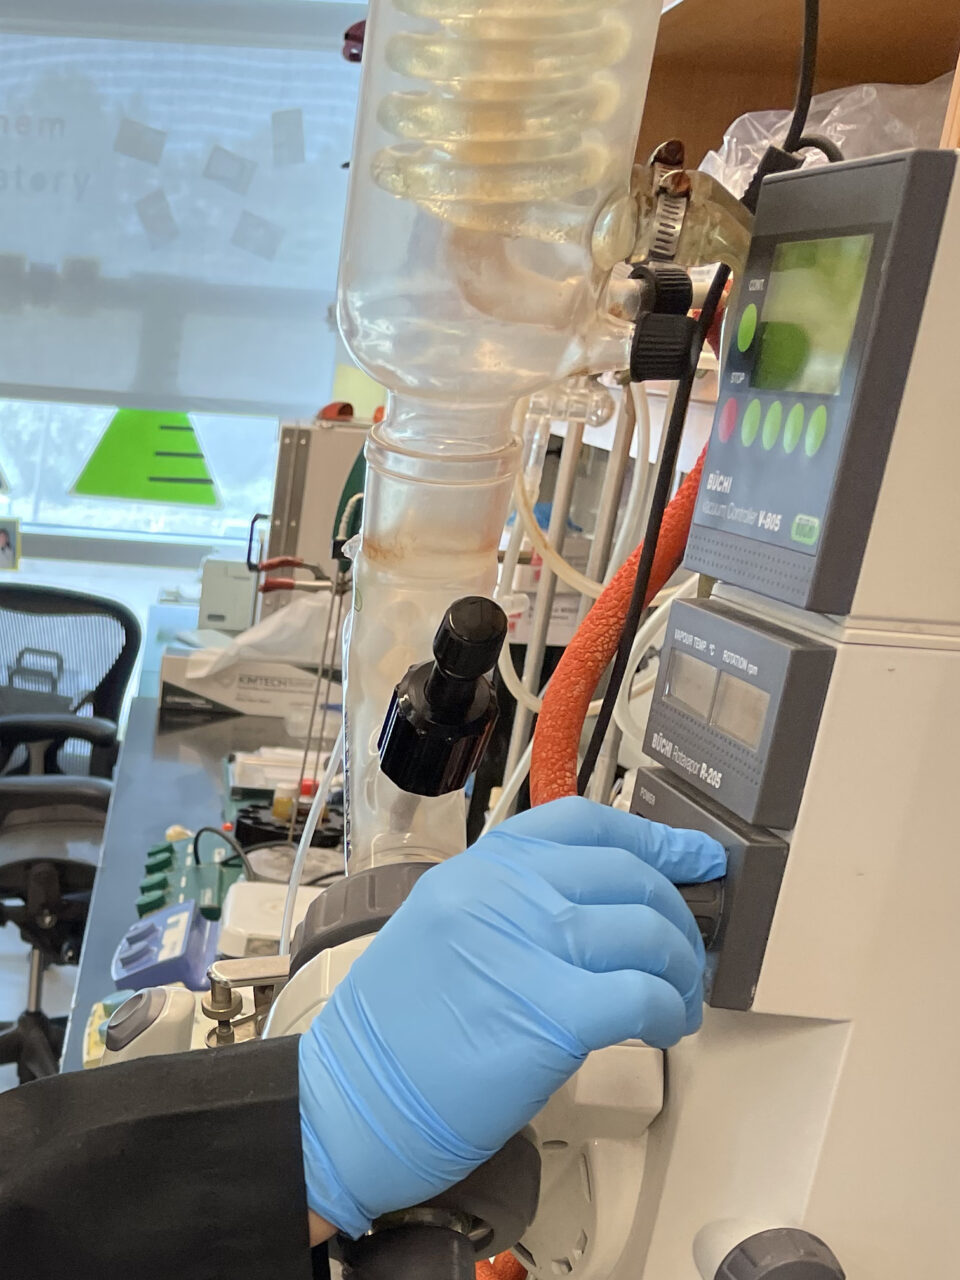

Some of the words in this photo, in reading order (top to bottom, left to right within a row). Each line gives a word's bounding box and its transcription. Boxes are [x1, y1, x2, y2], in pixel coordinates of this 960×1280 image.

[706, 470, 733, 494] BÜCHI
[238, 676, 289, 689] KIMTECH
[651, 732, 673, 759] BÜCHI
[671, 745, 701, 776] Rotavapor
[699, 761, 723, 790] R-205
